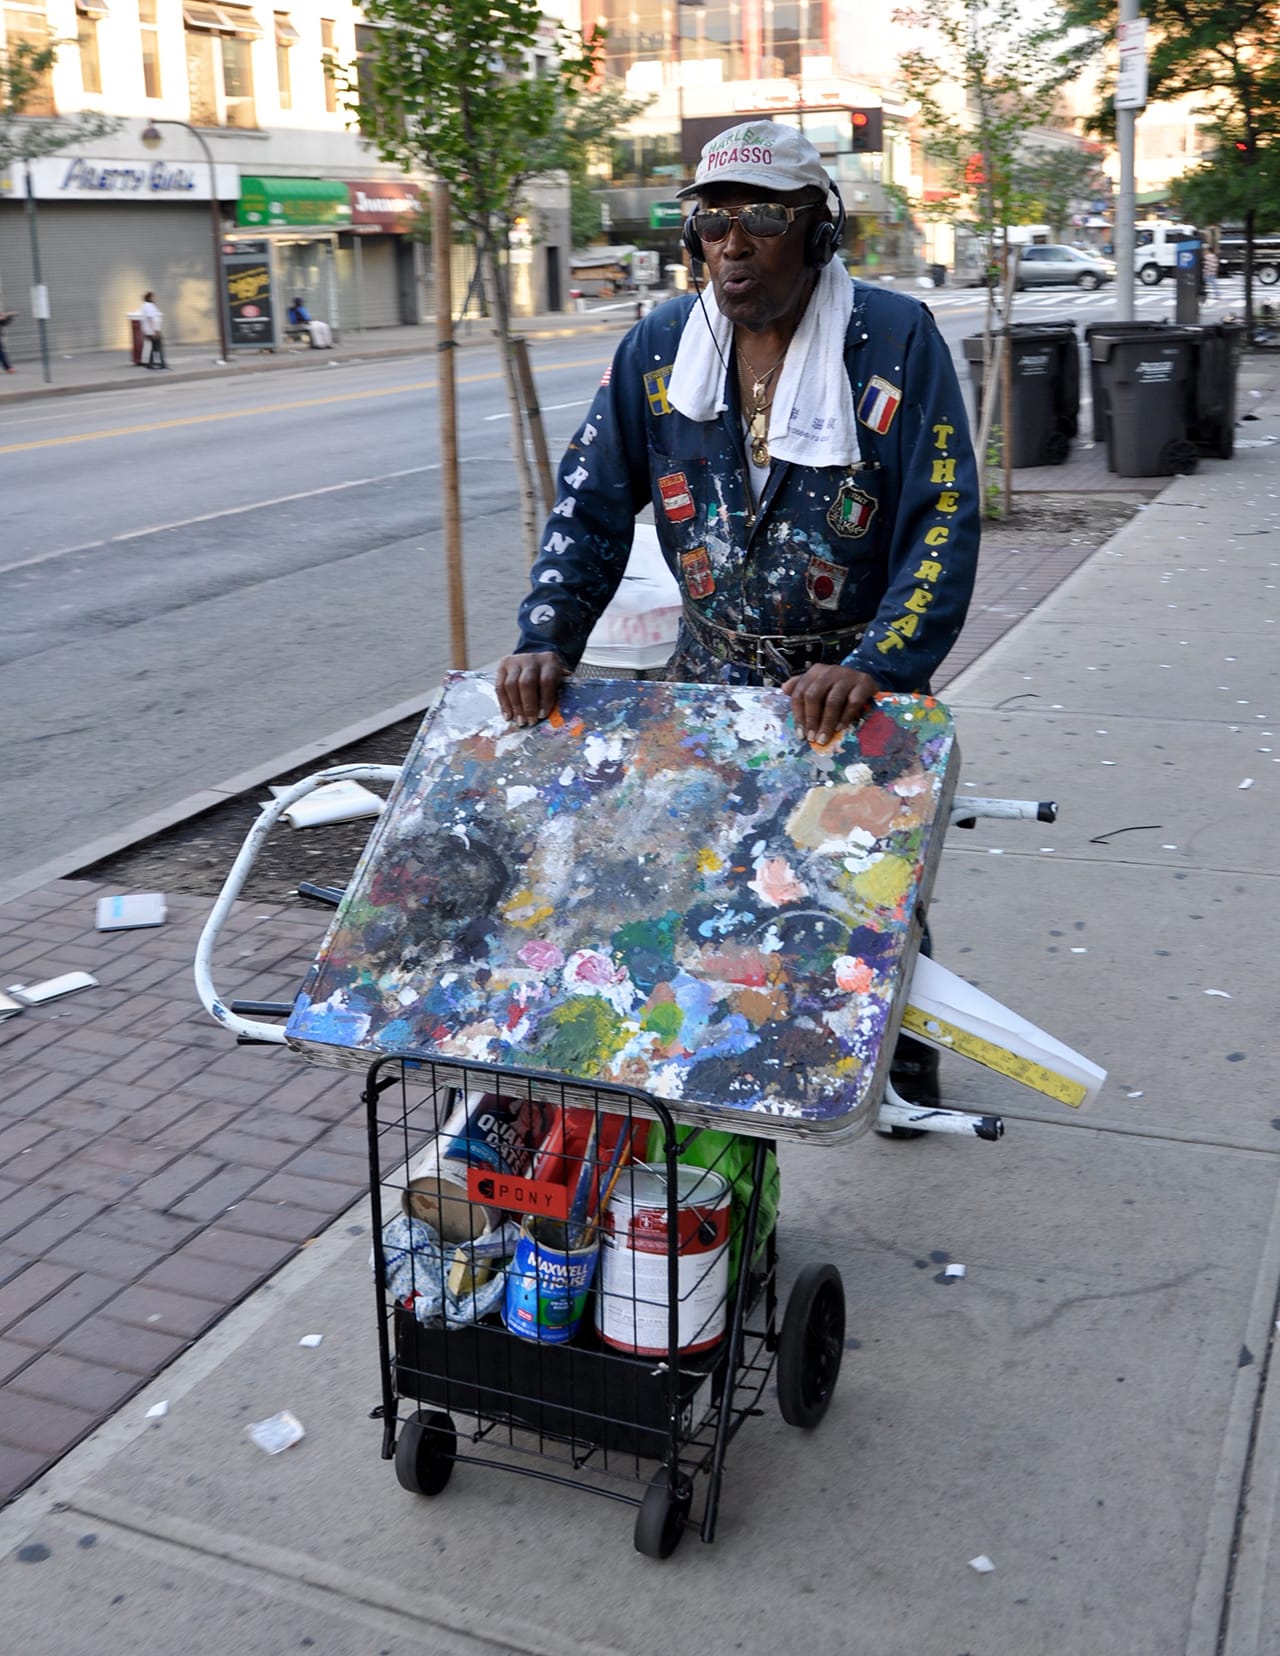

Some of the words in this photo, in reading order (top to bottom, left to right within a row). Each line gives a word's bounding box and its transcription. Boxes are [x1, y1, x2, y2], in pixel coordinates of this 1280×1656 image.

[707, 146, 772, 171] PICASSO
[499, 1185, 552, 1206] PONY
[528, 1251, 588, 1277] MAXWELL
[541, 1273, 587, 1290] HOUSE
